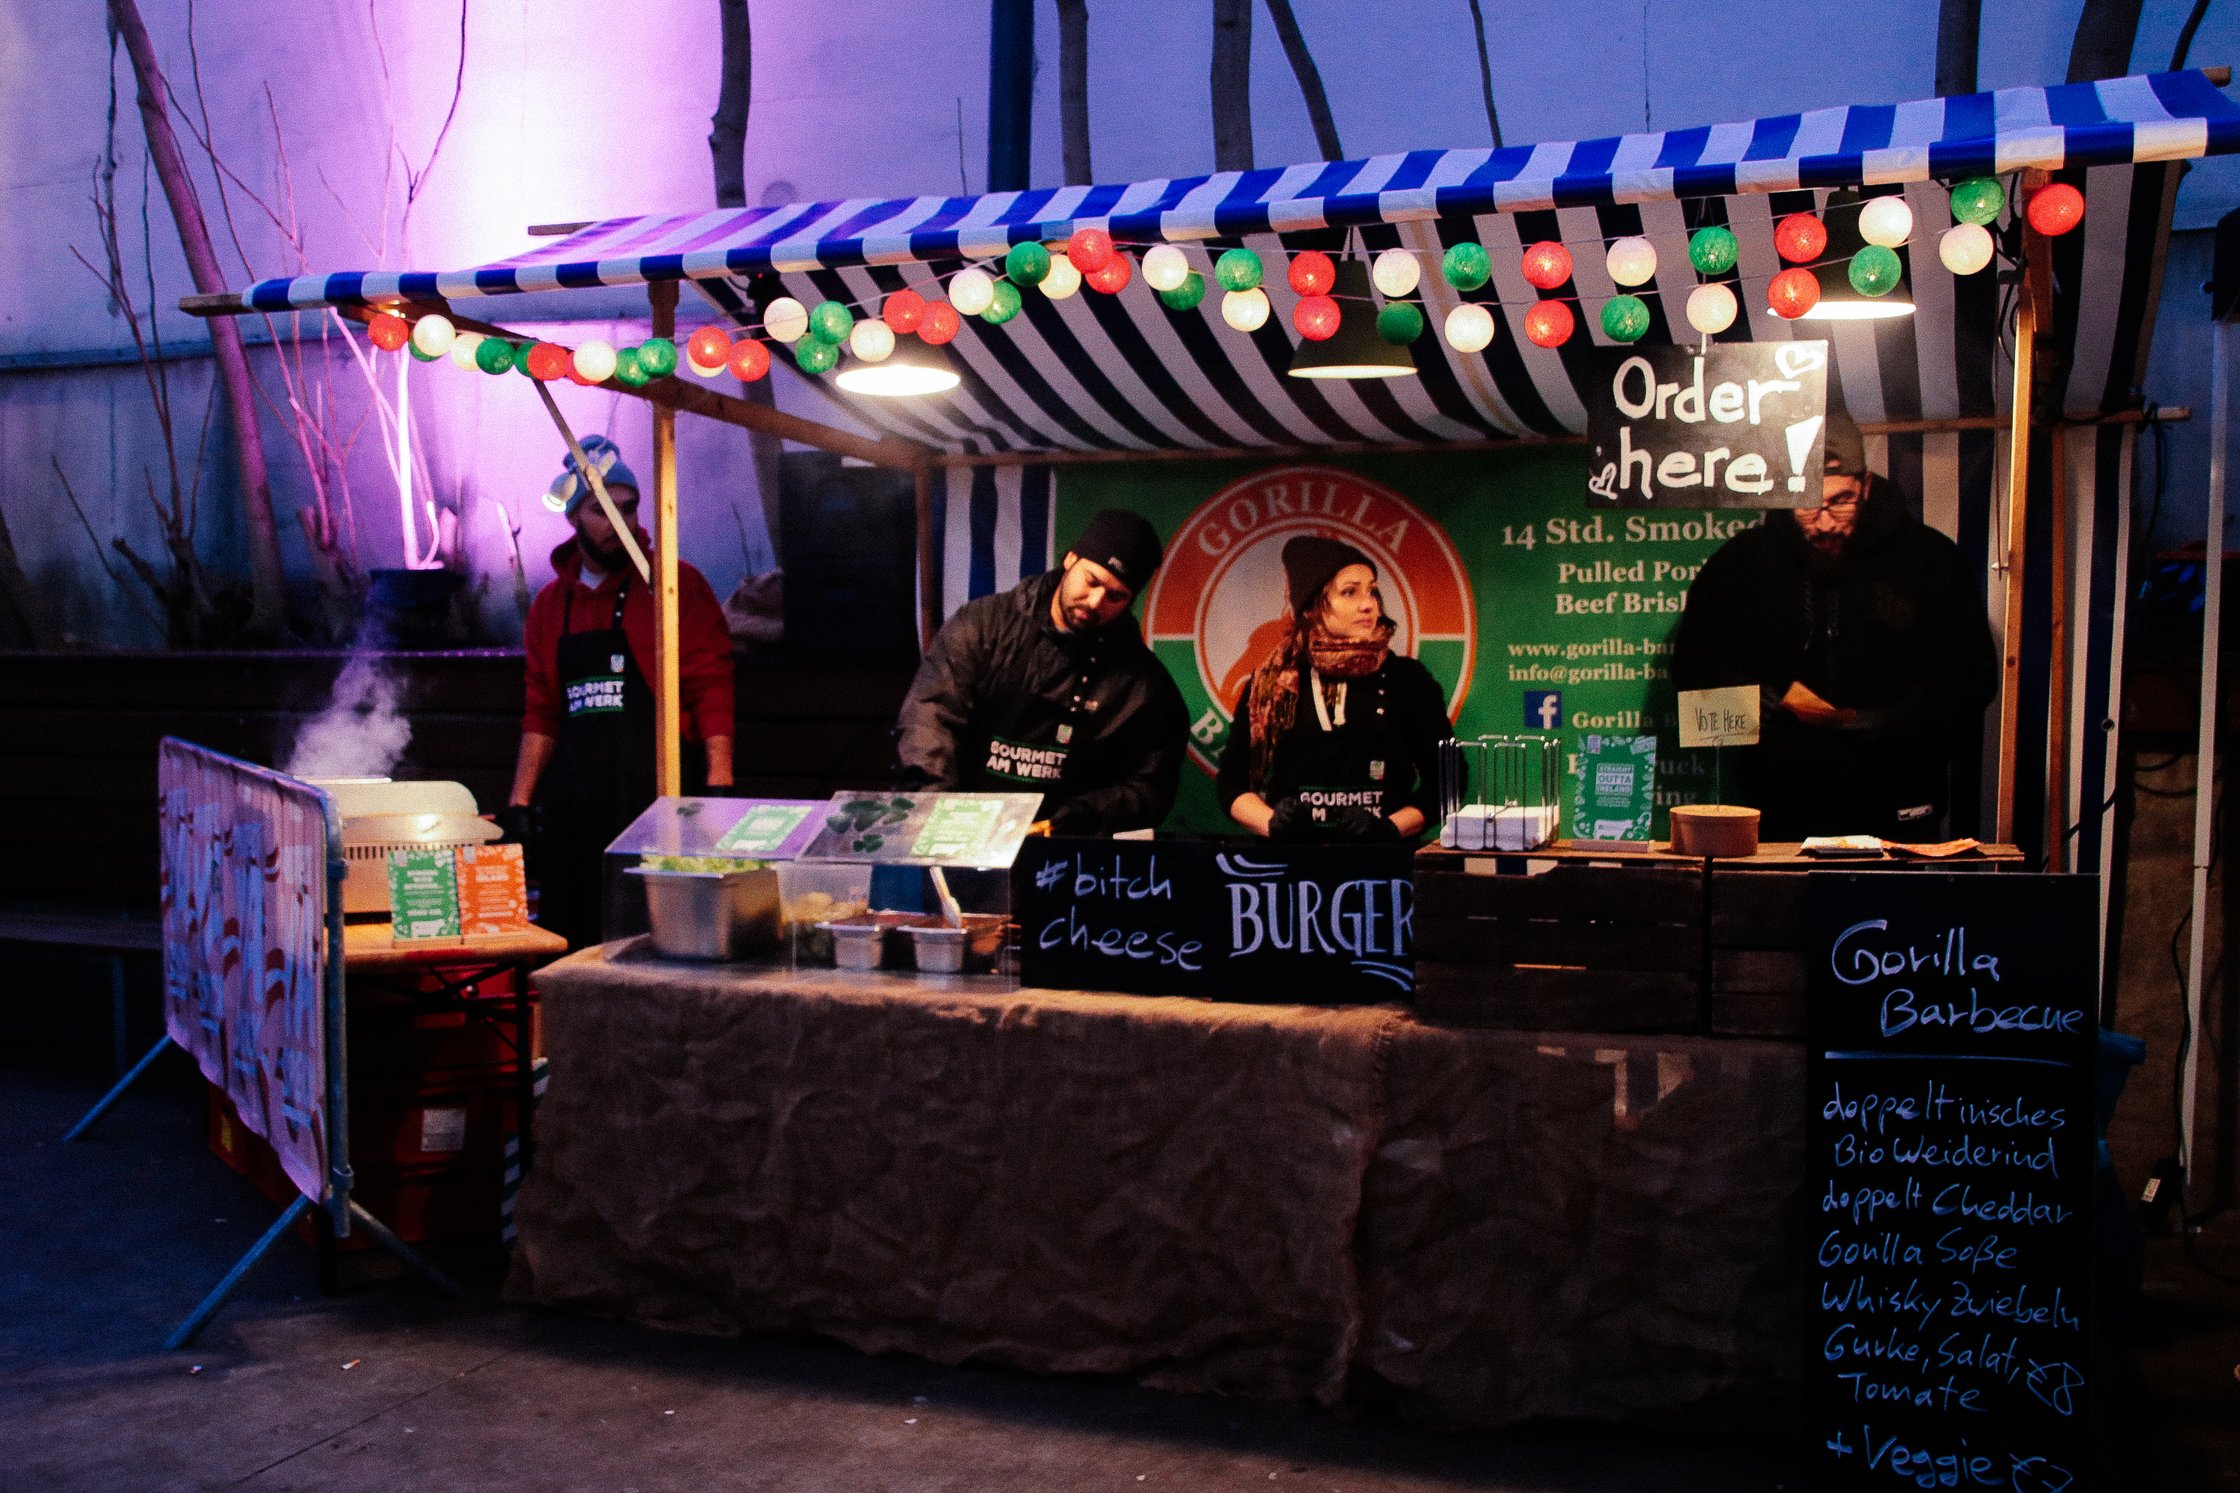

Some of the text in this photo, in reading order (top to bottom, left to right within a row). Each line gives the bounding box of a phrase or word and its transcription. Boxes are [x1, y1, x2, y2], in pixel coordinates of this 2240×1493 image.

[1613, 356, 1800, 425] Order
[1198, 480, 1409, 557] GORILLA
[1503, 525, 1537, 550] 14
[1546, 515, 1615, 545] Std.
[1558, 560, 1708, 584] Pulled Por
[1555, 592, 1617, 615] Beef
[1572, 710, 1654, 729] Gorilla
[1695, 707, 1719, 733] VOTE
[1723, 709, 1746, 733] HERE
[986, 755, 1062, 779] AM WERK
[990, 741, 1067, 766] GOURMET
[1300, 791, 1384, 806] GOURMET
[1036, 852, 1172, 900] #bitch
[1224, 878, 1414, 959] BURGER
[1831, 918, 2000, 985] Gorilla
[1879, 987, 2084, 1038] Barbecue
[1823, 1079, 1954, 1136] doppelt
[1822, 1178, 2074, 1226] doppelt Cheddar
[1820, 1275, 1942, 1332] Whisky
[1836, 1371, 1989, 1413] Tomate
[1826, 1423, 2007, 1489] + Veggie
